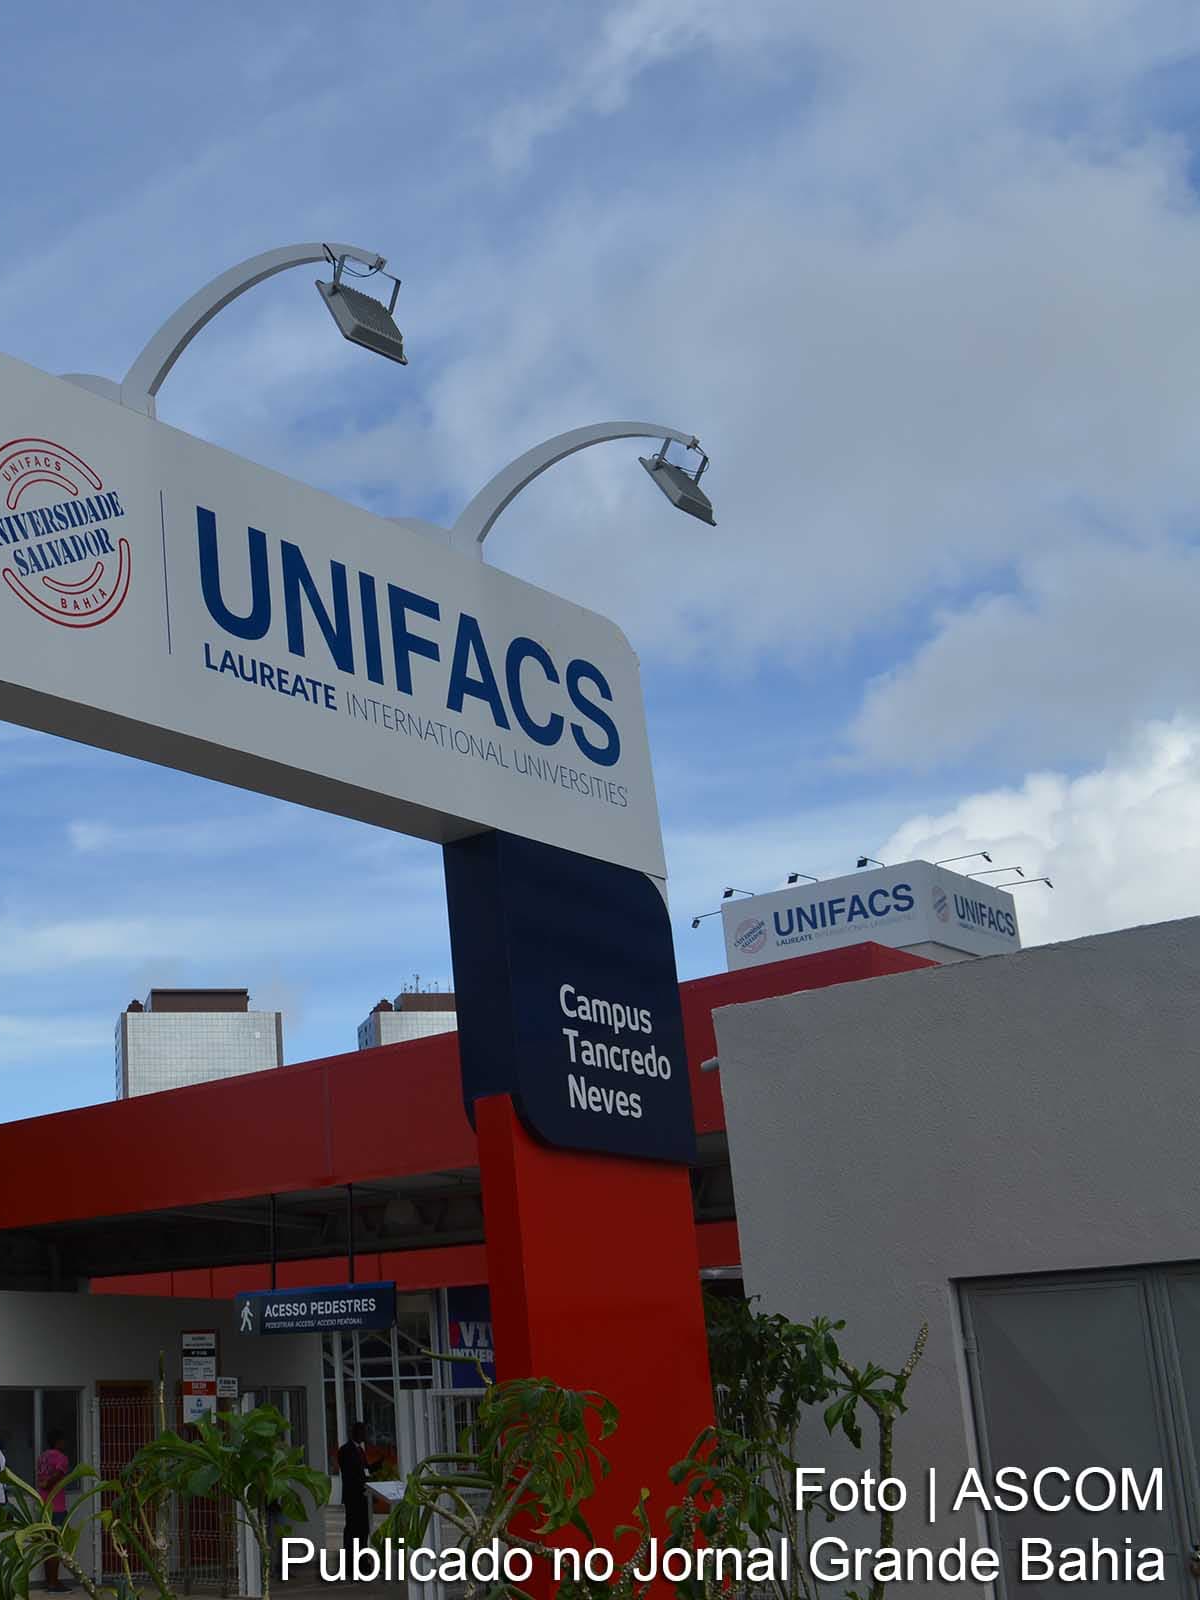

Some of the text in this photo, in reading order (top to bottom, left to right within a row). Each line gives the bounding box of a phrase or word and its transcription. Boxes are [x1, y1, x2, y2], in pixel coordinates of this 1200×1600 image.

[3, 456, 62, 481] UNIFACS
[13, 528, 116, 577] SALVADOR
[60, 588, 108, 610] BAHIA
[196, 506, 621, 767] UNIFACS
[204, 643, 628, 807] LAUREATE INTERNATIONAL UNIVERSITIES
[773, 884, 915, 937] UNIFACS
[953, 893, 1016, 937] UNIFACS
[560, 984, 652, 1034] Campus
[562, 1028, 671, 1080] Tancredo
[568, 1073, 642, 1118] Neves
[264, 1298, 377, 1318] ACESSO PEDESTRES
